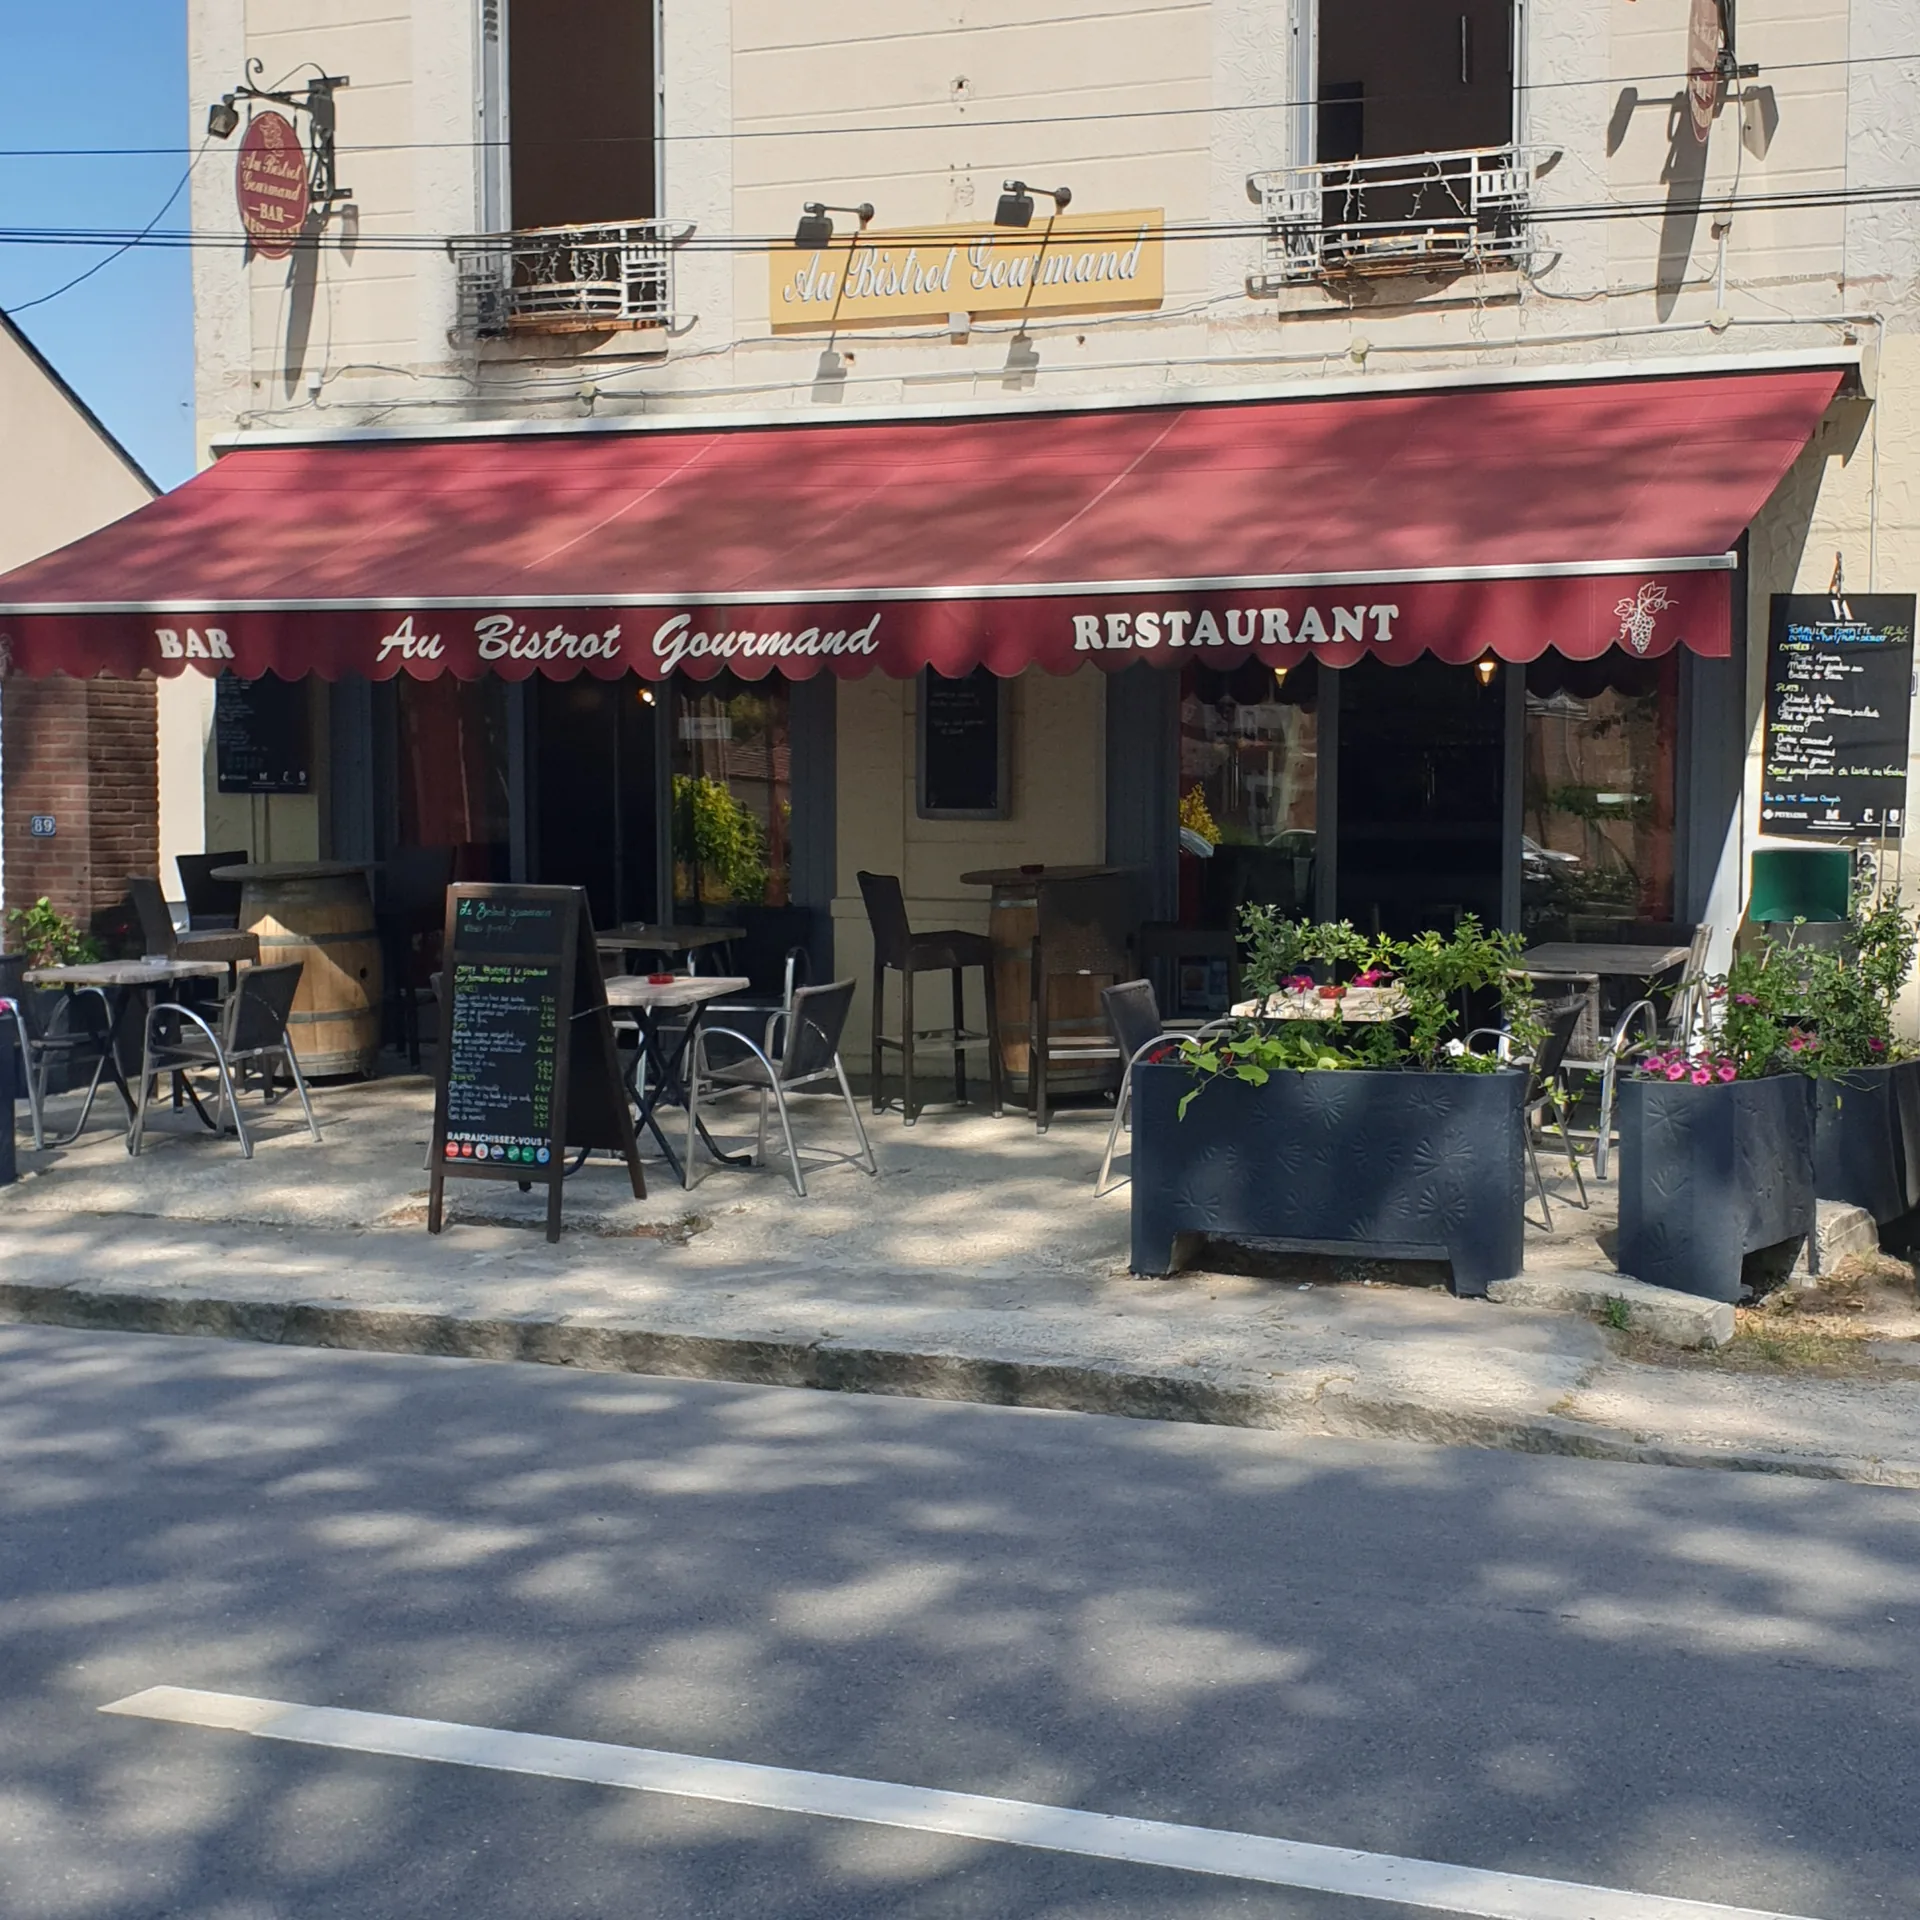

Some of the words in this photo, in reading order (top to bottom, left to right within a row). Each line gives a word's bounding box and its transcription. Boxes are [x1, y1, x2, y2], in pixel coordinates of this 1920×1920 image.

[241, 151, 261, 171] Au
[262, 154, 302, 181] Bistrot
[242, 171, 302, 201] Gourmand
[260, 202, 284, 223] BAR
[783, 248, 836, 304] Au
[843, 241, 959, 300] Bistrot
[967, 222, 1149, 291] Gourmand
[154, 627, 235, 659] BAR
[376, 615, 446, 663] Au
[474, 613, 622, 661] Bistrot
[652, 612, 882, 674] Gourmand
[1072, 604, 1399, 651] RESTAURANT
[34, 819, 53, 833] 89
